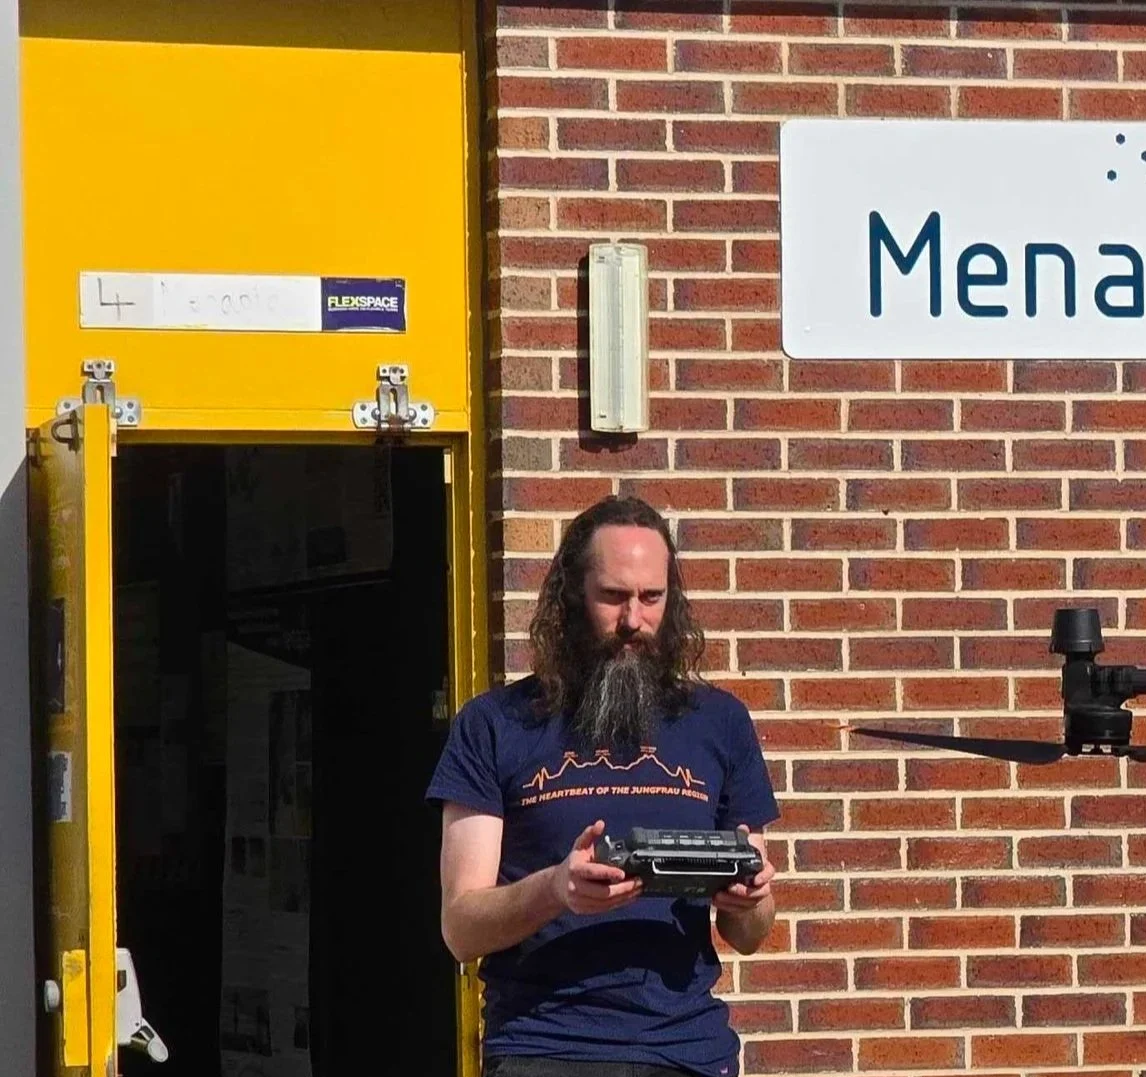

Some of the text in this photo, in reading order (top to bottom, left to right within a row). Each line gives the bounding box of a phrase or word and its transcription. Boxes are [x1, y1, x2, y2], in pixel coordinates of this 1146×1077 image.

[97, 277, 135, 321] 4
[327, 295, 399, 308] FLEXSPACE
[521, 796, 537, 806] THE
[539, 787, 594, 802] HEARTBEAT
[596, 786, 609, 795] OF
[611, 786, 629, 795] THE
[630, 786, 680, 795] JUNGFRAU
